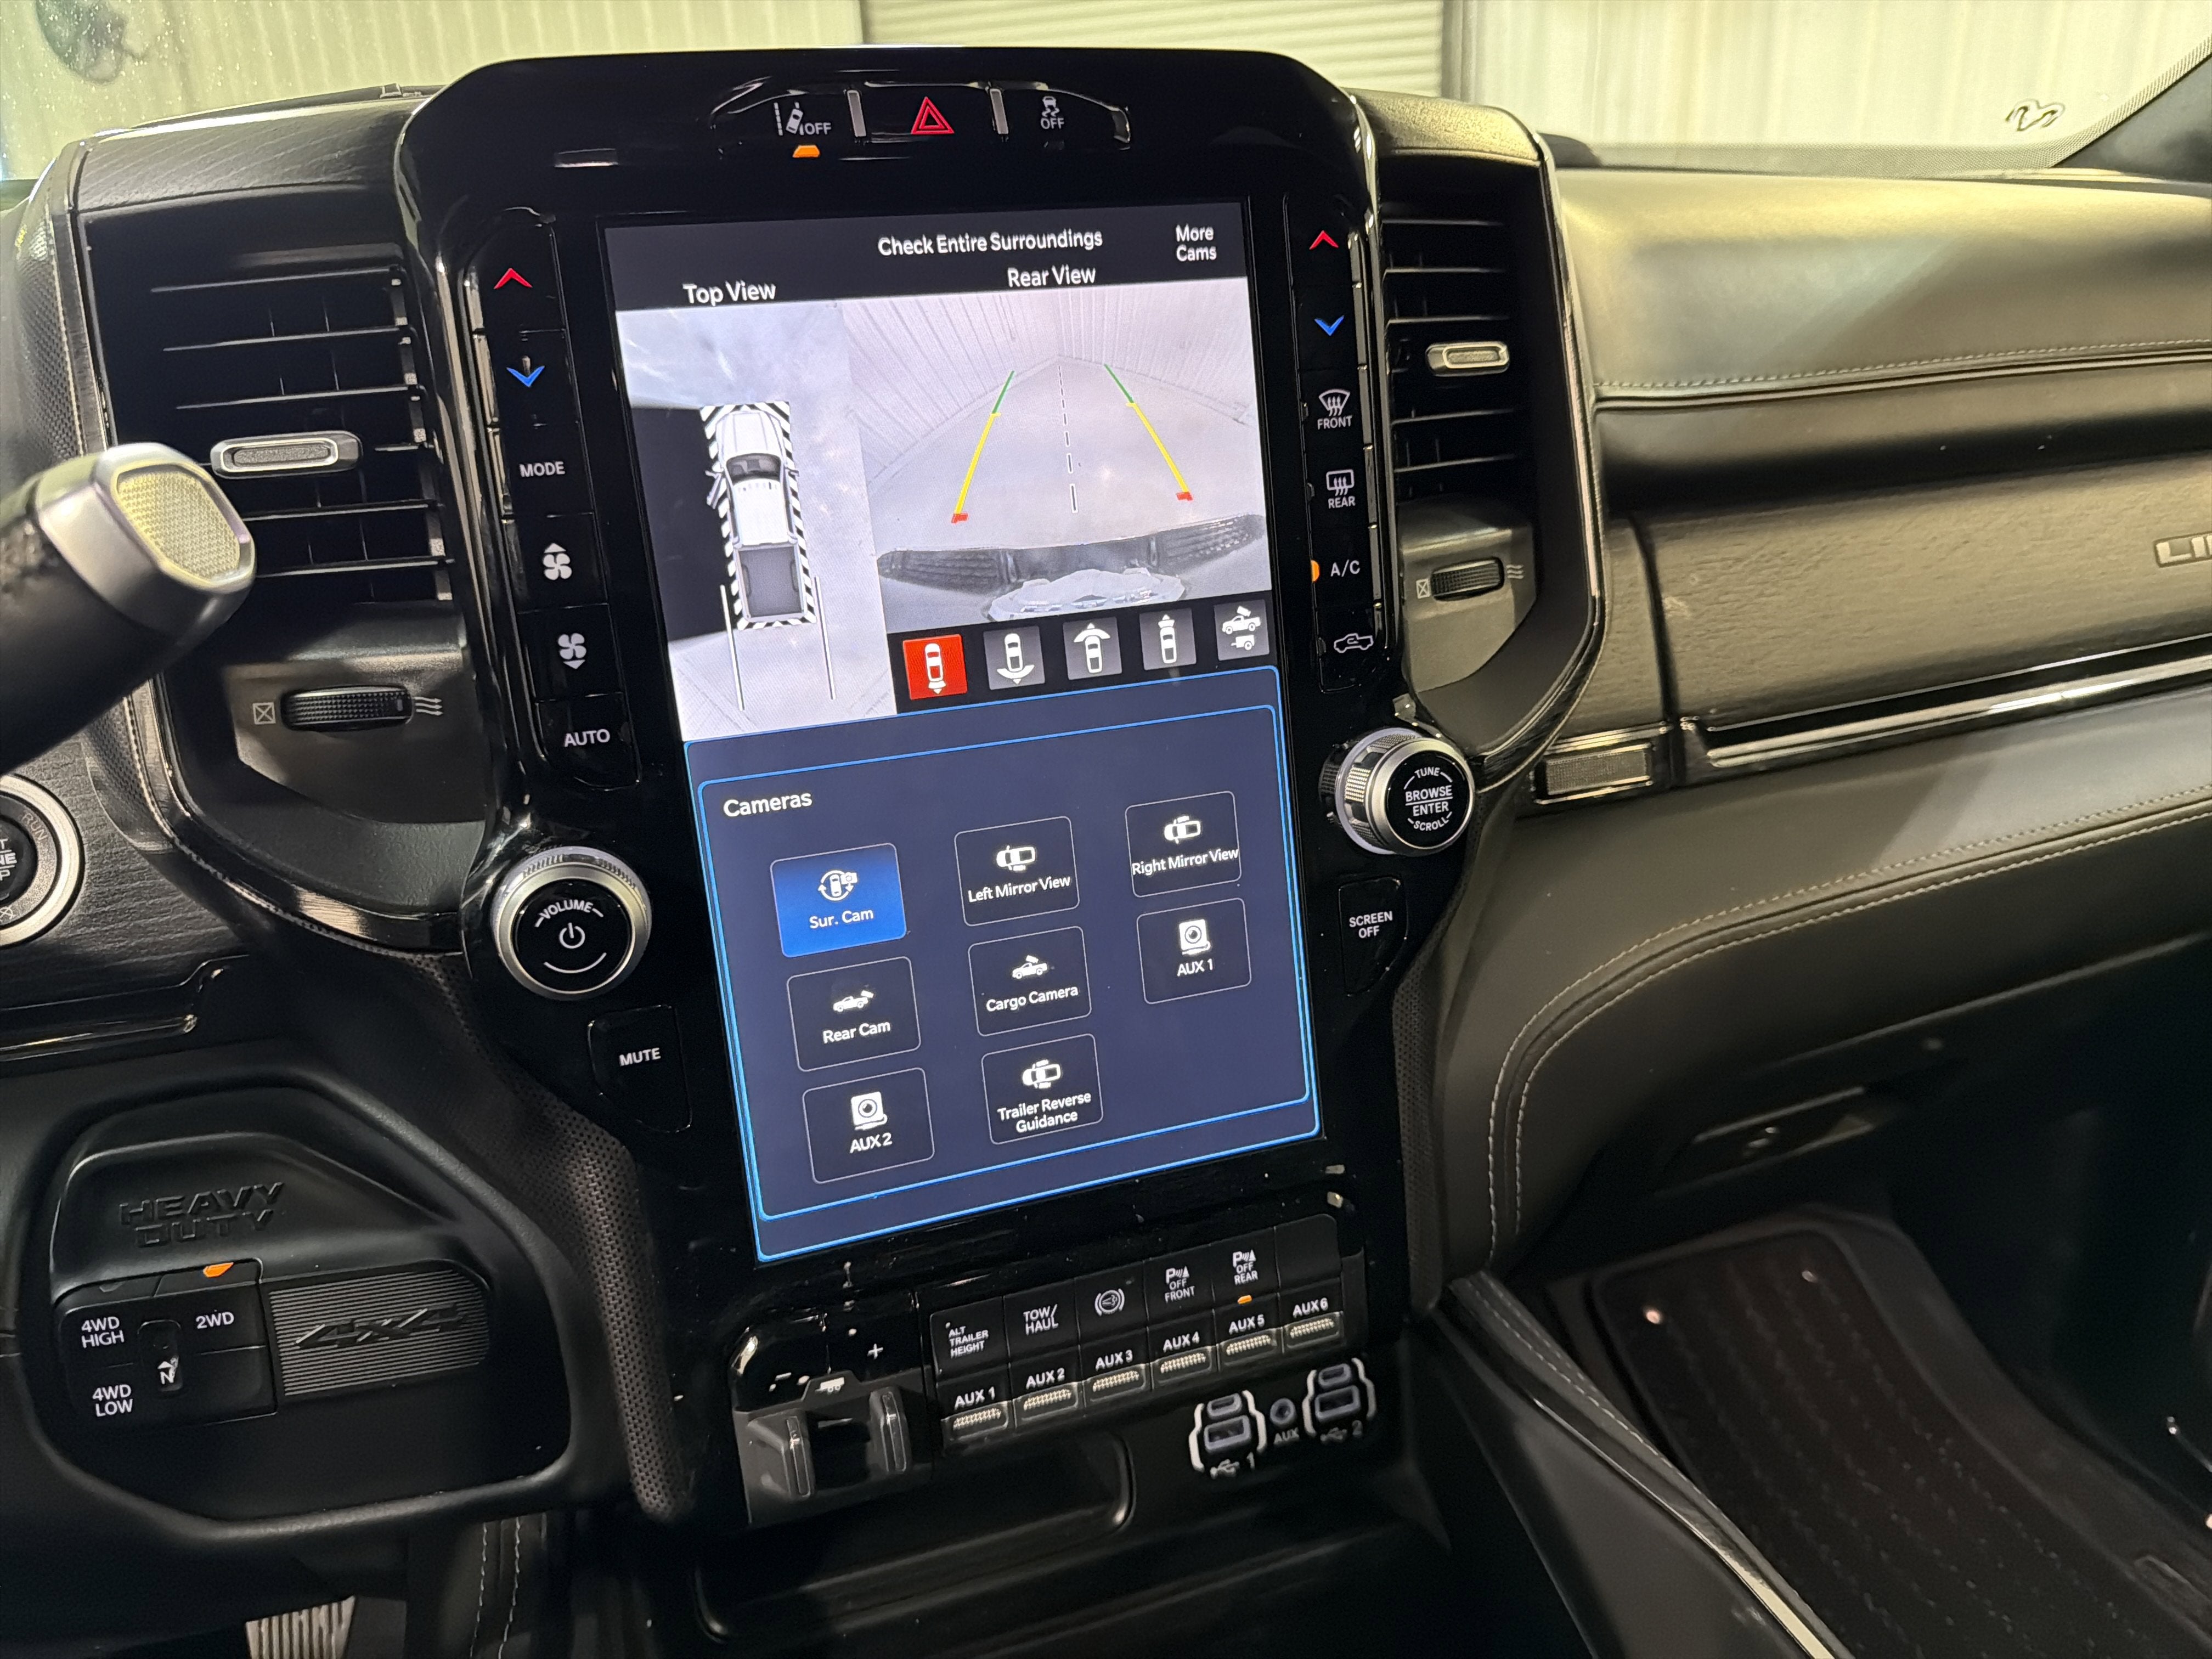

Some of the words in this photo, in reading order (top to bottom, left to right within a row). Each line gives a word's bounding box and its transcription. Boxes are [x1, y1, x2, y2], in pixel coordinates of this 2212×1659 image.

[805, 122, 832, 136] OFF
[1040, 117, 1065, 130] OFF
[878, 235, 934, 257] Check
[936, 233, 988, 254] Entire
[990, 228, 1103, 252] Surroundings
[1175, 223, 1214, 242] More
[1176, 244, 1217, 262] Cams
[1007, 267, 1049, 289] Rear
[1051, 264, 1097, 285] View
[682, 282, 724, 307] Top
[725, 279, 777, 302] View
[1317, 414, 1353, 430] FRONT
[518, 460, 566, 478] MODE
[1327, 495, 1356, 509] REAR
[1330, 558, 1361, 578] A/C
[563, 728, 611, 748] AUTO
[1414, 766, 1441, 779] TUNE
[1404, 785, 1453, 803] BROWSE
[723, 792, 813, 818] Cameras
[1412, 802, 1450, 817] ENTER
[21, 812, 48, 841] RUN
[1413, 816, 1451, 832] SCROLL
[1131, 858, 1167, 877] Right
[1168, 851, 1208, 870] Mirror
[1208, 846, 1239, 864] View
[967, 885, 995, 904] Left
[996, 878, 1038, 899] Mirror
[1039, 874, 1071, 891] View
[539, 899, 594, 921] VOLUME
[809, 913, 839, 930] Sur.
[841, 907, 874, 924] Cam
[1348, 910, 1393, 928] SCREEN
[1358, 925, 1380, 939] OFF
[1176, 960, 1206, 978] AUX
[1206, 957, 1214, 971] 1
[986, 994, 1028, 1014] Cargo
[1028, 984, 1079, 1005] Camera
[822, 1027, 857, 1045] Rear
[858, 1019, 891, 1037] Cam
[618, 1047, 662, 1067] MUTE
[996, 1102, 1040, 1123] Trailer
[1040, 1091, 1092, 1113] Reverse
[1015, 1109, 1079, 1134] Guidance
[849, 1134, 882, 1154] AUX
[882, 1131, 893, 1147] 2
[119, 1182, 285, 1225] HEAVY
[134, 1209, 274, 1248] DUTY
[1234, 1270, 1259, 1286] REAR
[1235, 1261, 1254, 1275] OFF
[1169, 1277, 1187, 1291] OFF
[1164, 1285, 1195, 1304] FRONT
[1023, 1304, 1058, 1322] TOW/
[1292, 1300, 1320, 1318] AUX
[1320, 1297, 1329, 1311] 6
[81, 1316, 120, 1334] 4WD
[195, 1311, 235, 1329] 2WD
[1024, 1317, 1059, 1336] HAUL
[1228, 1316, 1256, 1335] AUX
[1257, 1314, 1265, 1328] 5
[81, 1329, 125, 1349] HIGH
[948, 1325, 966, 1338] ALT
[949, 1329, 989, 1348] TRAILER
[950, 1341, 985, 1359] HEIGHT
[1163, 1334, 1191, 1353] AUX
[1192, 1331, 1200, 1345] 4
[1094, 1352, 1124, 1372] AUX
[1125, 1350, 1133, 1363] 3
[1025, 1371, 1056, 1390] AUX
[1057, 1368, 1065, 1382] 2
[92, 1384, 132, 1402] 4WD
[953, 1388, 985, 1410] AUX
[988, 1386, 996, 1400] 1
[94, 1398, 133, 1418] LOW
[1273, 1426, 1300, 1446] AUX
